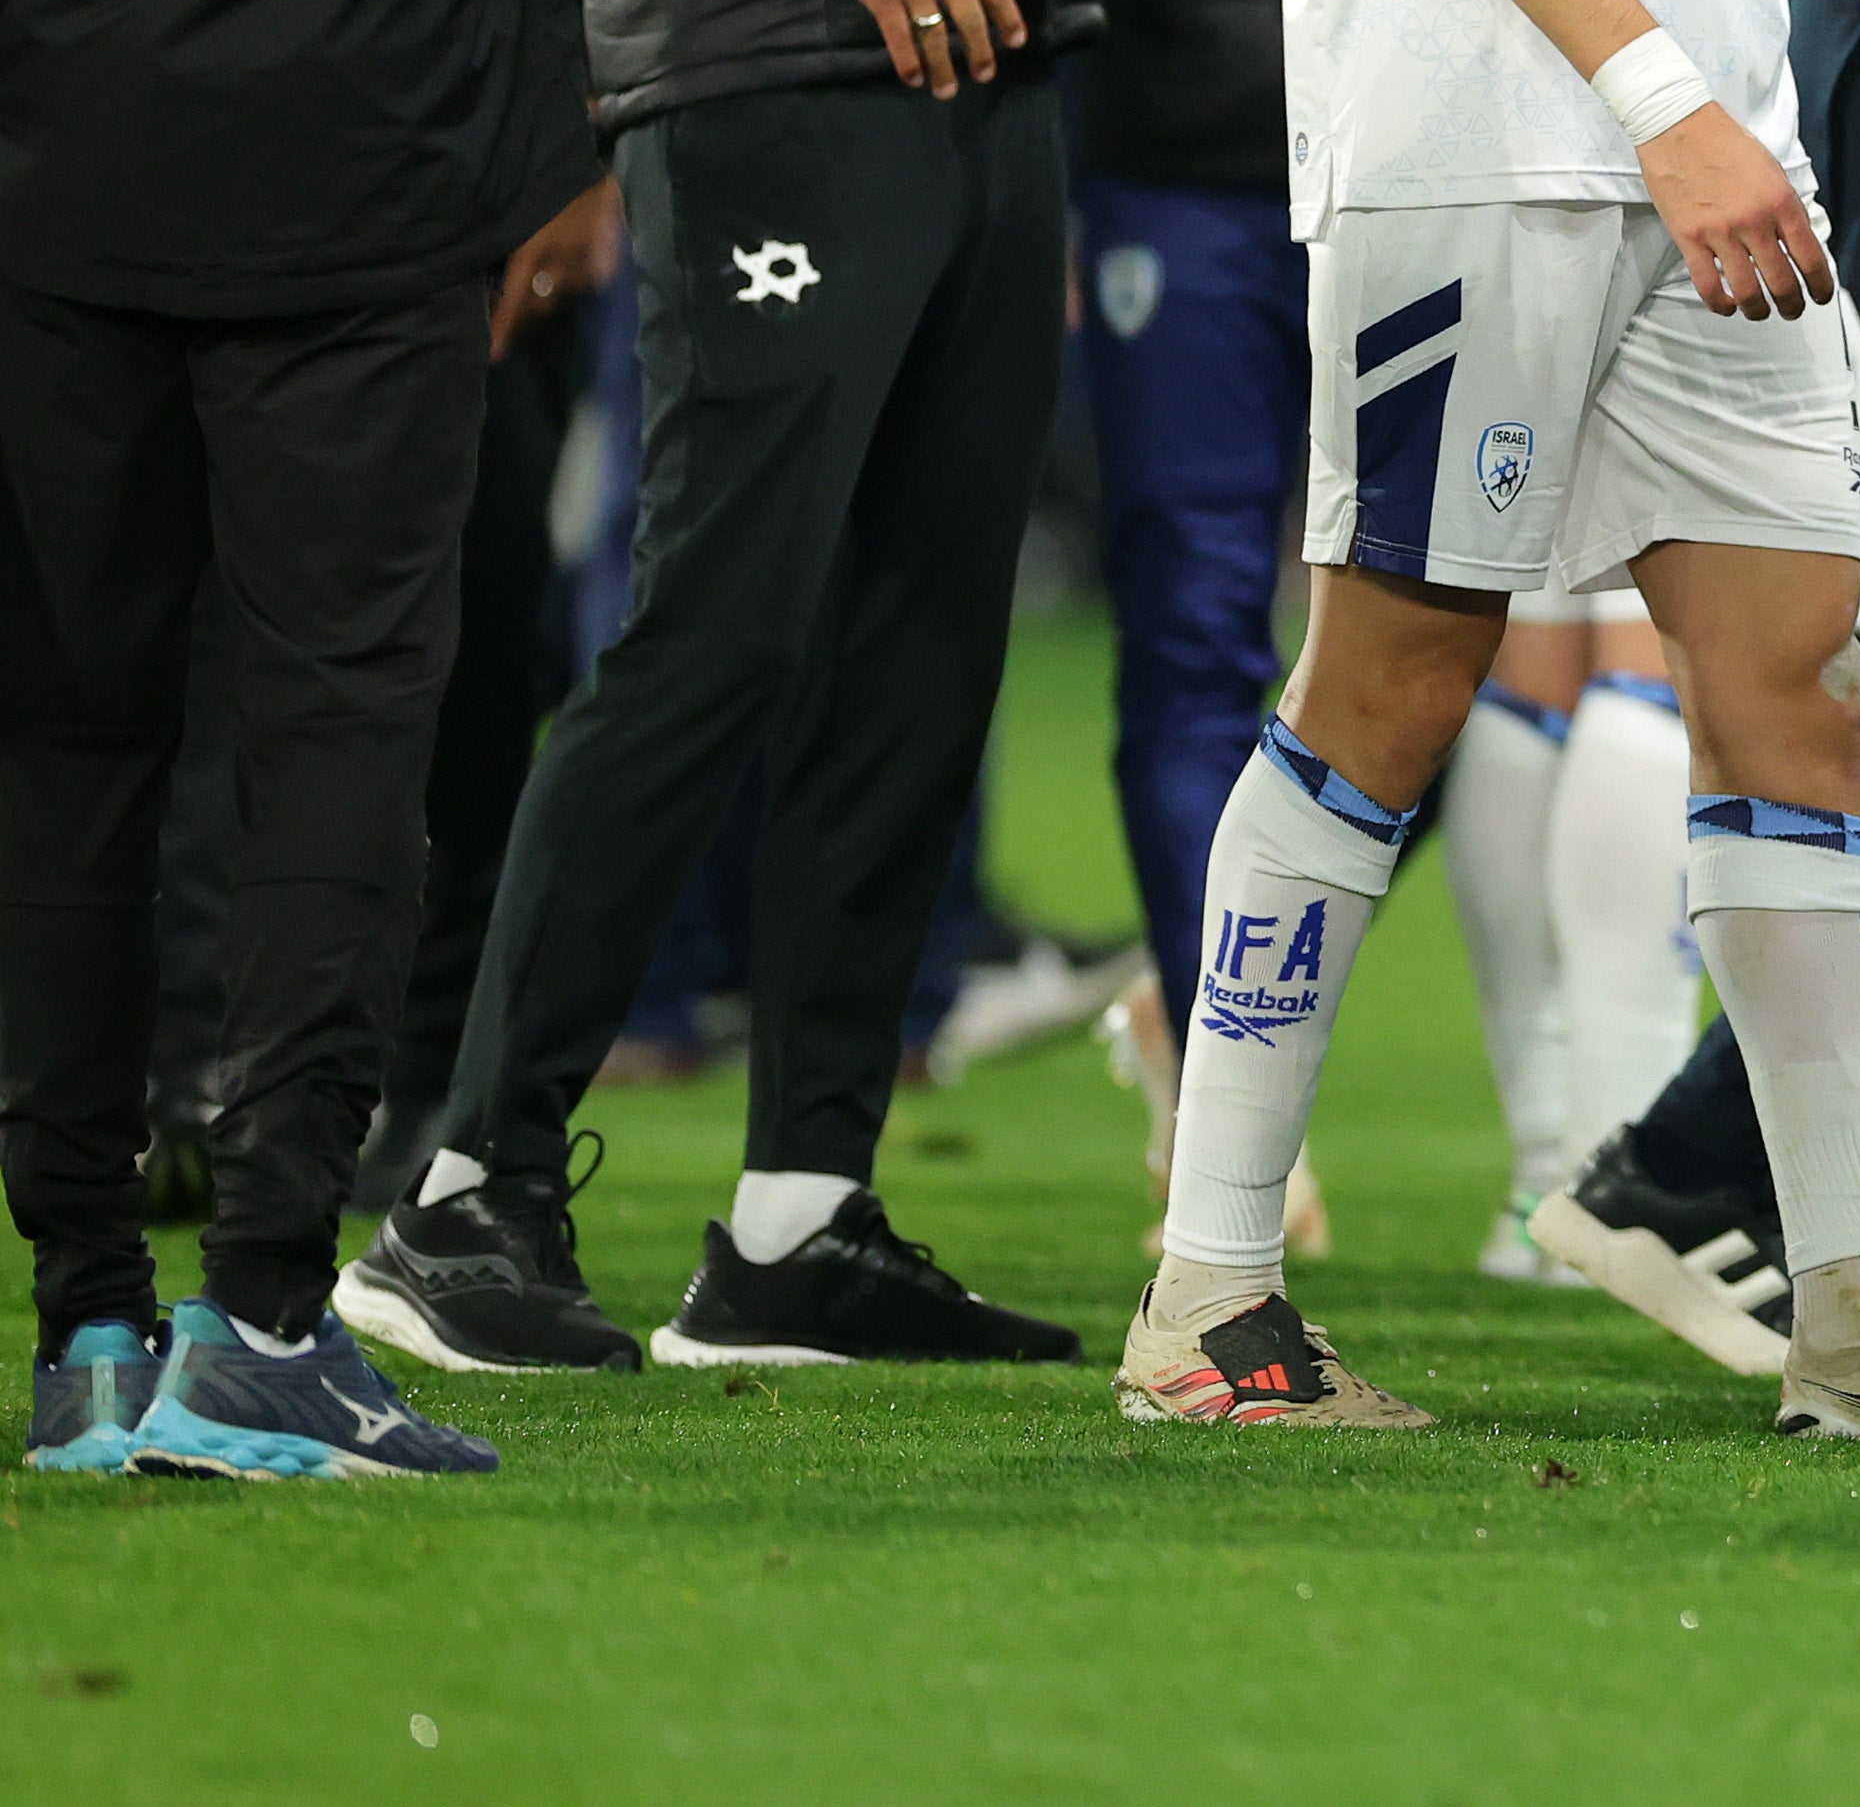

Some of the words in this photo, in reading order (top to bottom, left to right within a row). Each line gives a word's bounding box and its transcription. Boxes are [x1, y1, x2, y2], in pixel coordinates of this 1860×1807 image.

[1492, 430, 1527, 445] ISRAEL
[1215, 898, 1329, 981] IFA
[1204, 972, 1320, 1013] Reebok
